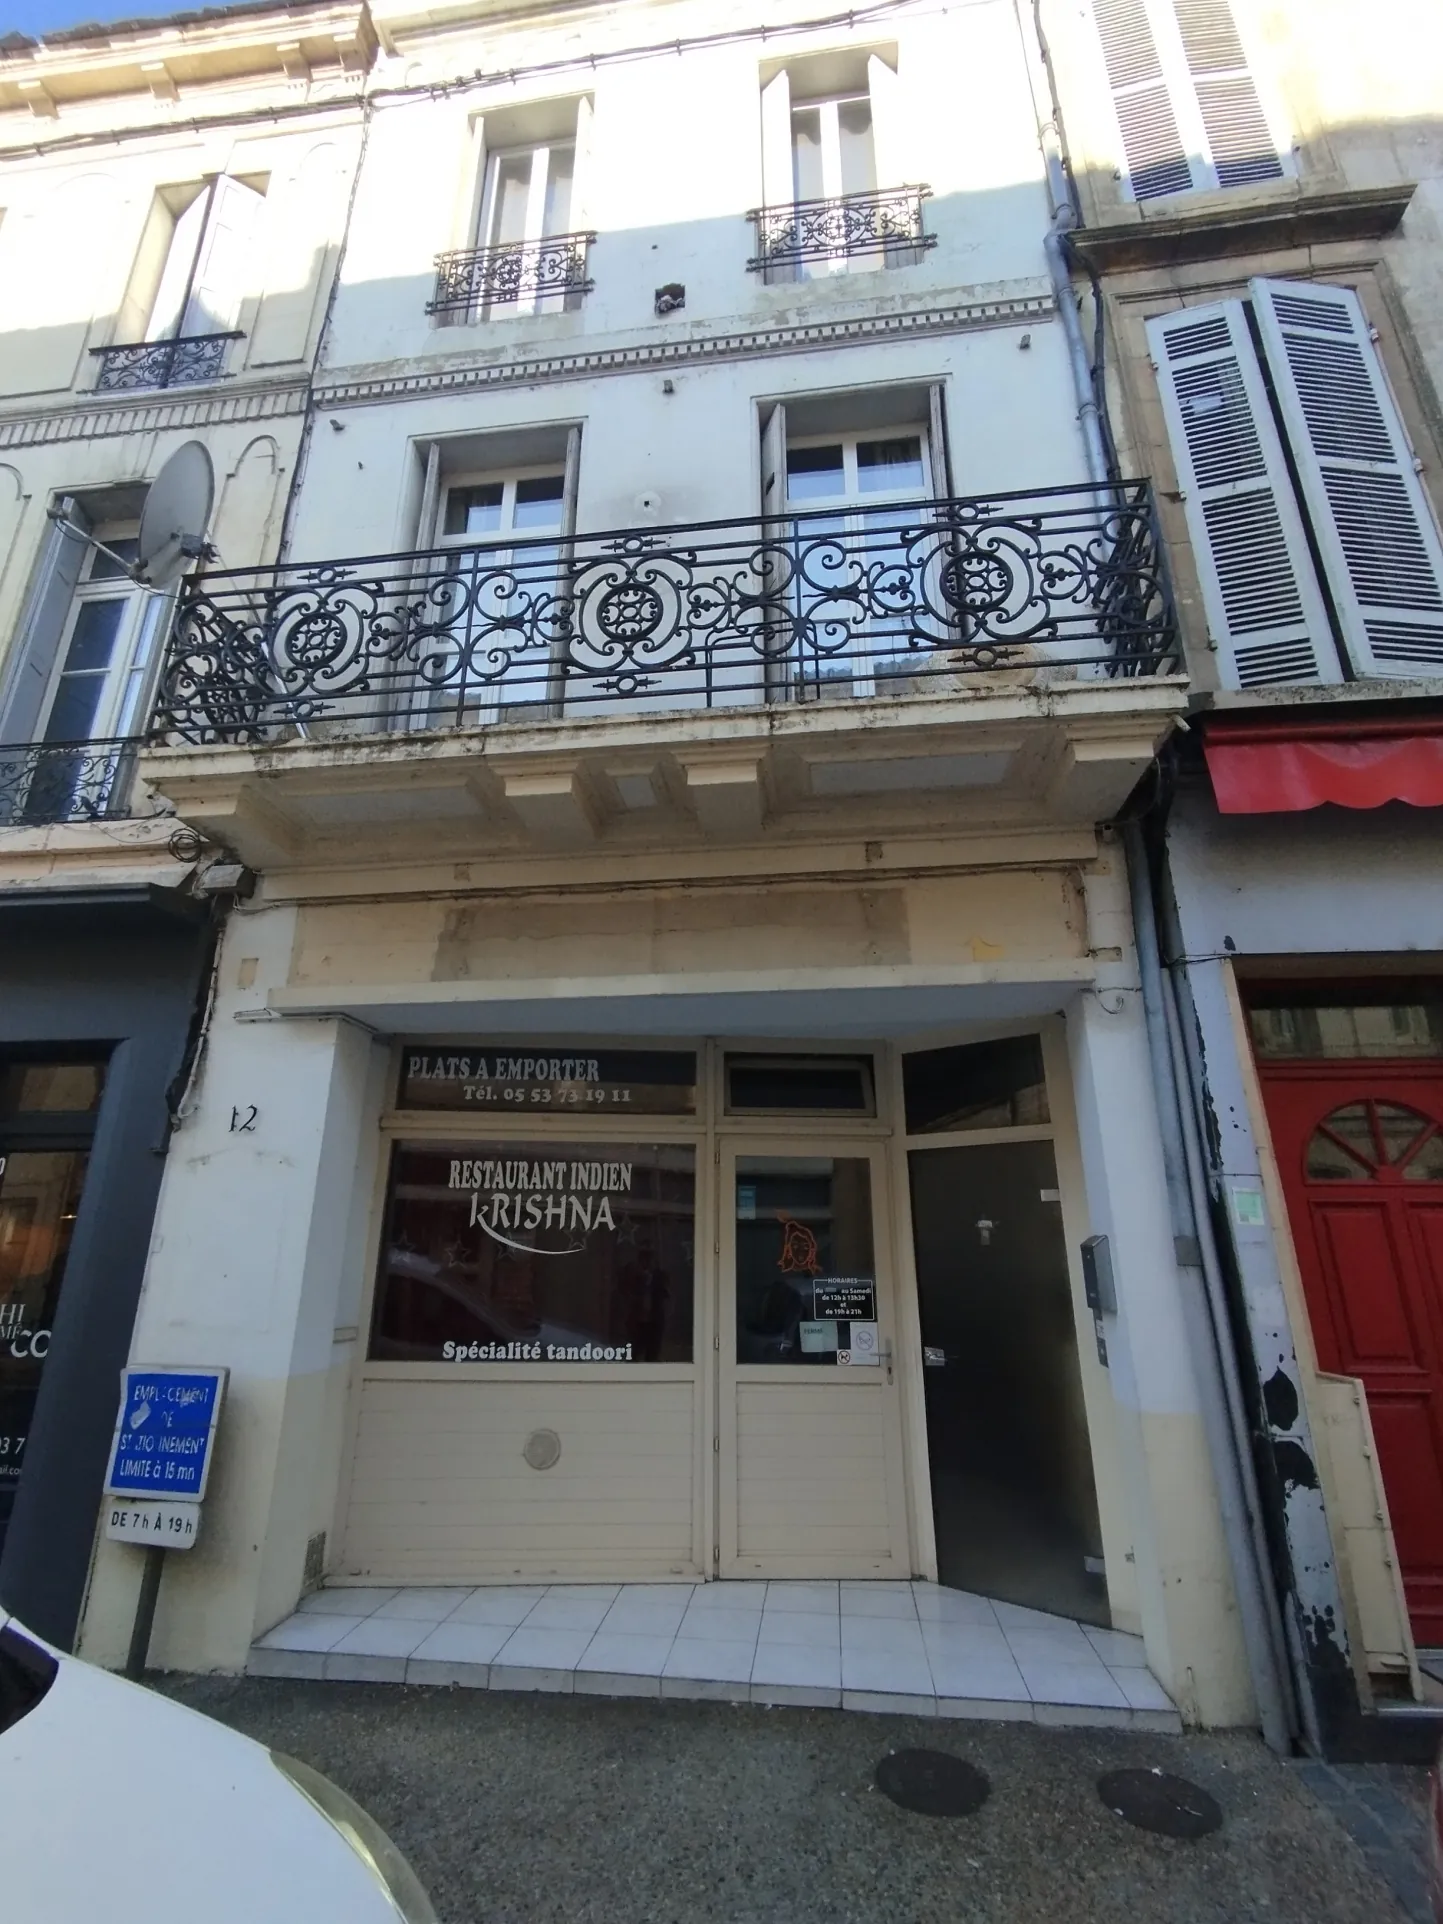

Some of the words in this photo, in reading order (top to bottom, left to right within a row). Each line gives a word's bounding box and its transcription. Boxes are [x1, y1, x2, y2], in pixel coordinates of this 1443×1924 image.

[408, 1056, 471, 1079] PLATS
[475, 1058, 489, 1079] A
[495, 1057, 600, 1081] EMPORTER
[464, 1085, 498, 1100] Tél.
[504, 1088, 524, 1102] 05
[531, 1088, 552, 1102] 53
[558, 1089, 579, 1103] 73
[586, 1089, 606, 1103] 19
[611, 1089, 631, 1101] 11
[229, 1104, 257, 1132] 12
[449, 1160, 566, 1190] RESTAURANT
[570, 1162, 632, 1190] INDIEN
[442, 1341, 541, 1363] Spécialité
[547, 1343, 632, 1360] tandoori
[134, 1385, 209, 1403] EMPLCEMENT
[0, 1437, 10, 1454] 3
[120, 1433, 204, 1454] STTIONEMENT
[120, 1459, 151, 1477] LIMITE
[153, 1460, 161, 1478] à
[164, 1461, 175, 1479] 15
[177, 1466, 195, 1480] mn
[111, 1511, 128, 1527] DE
